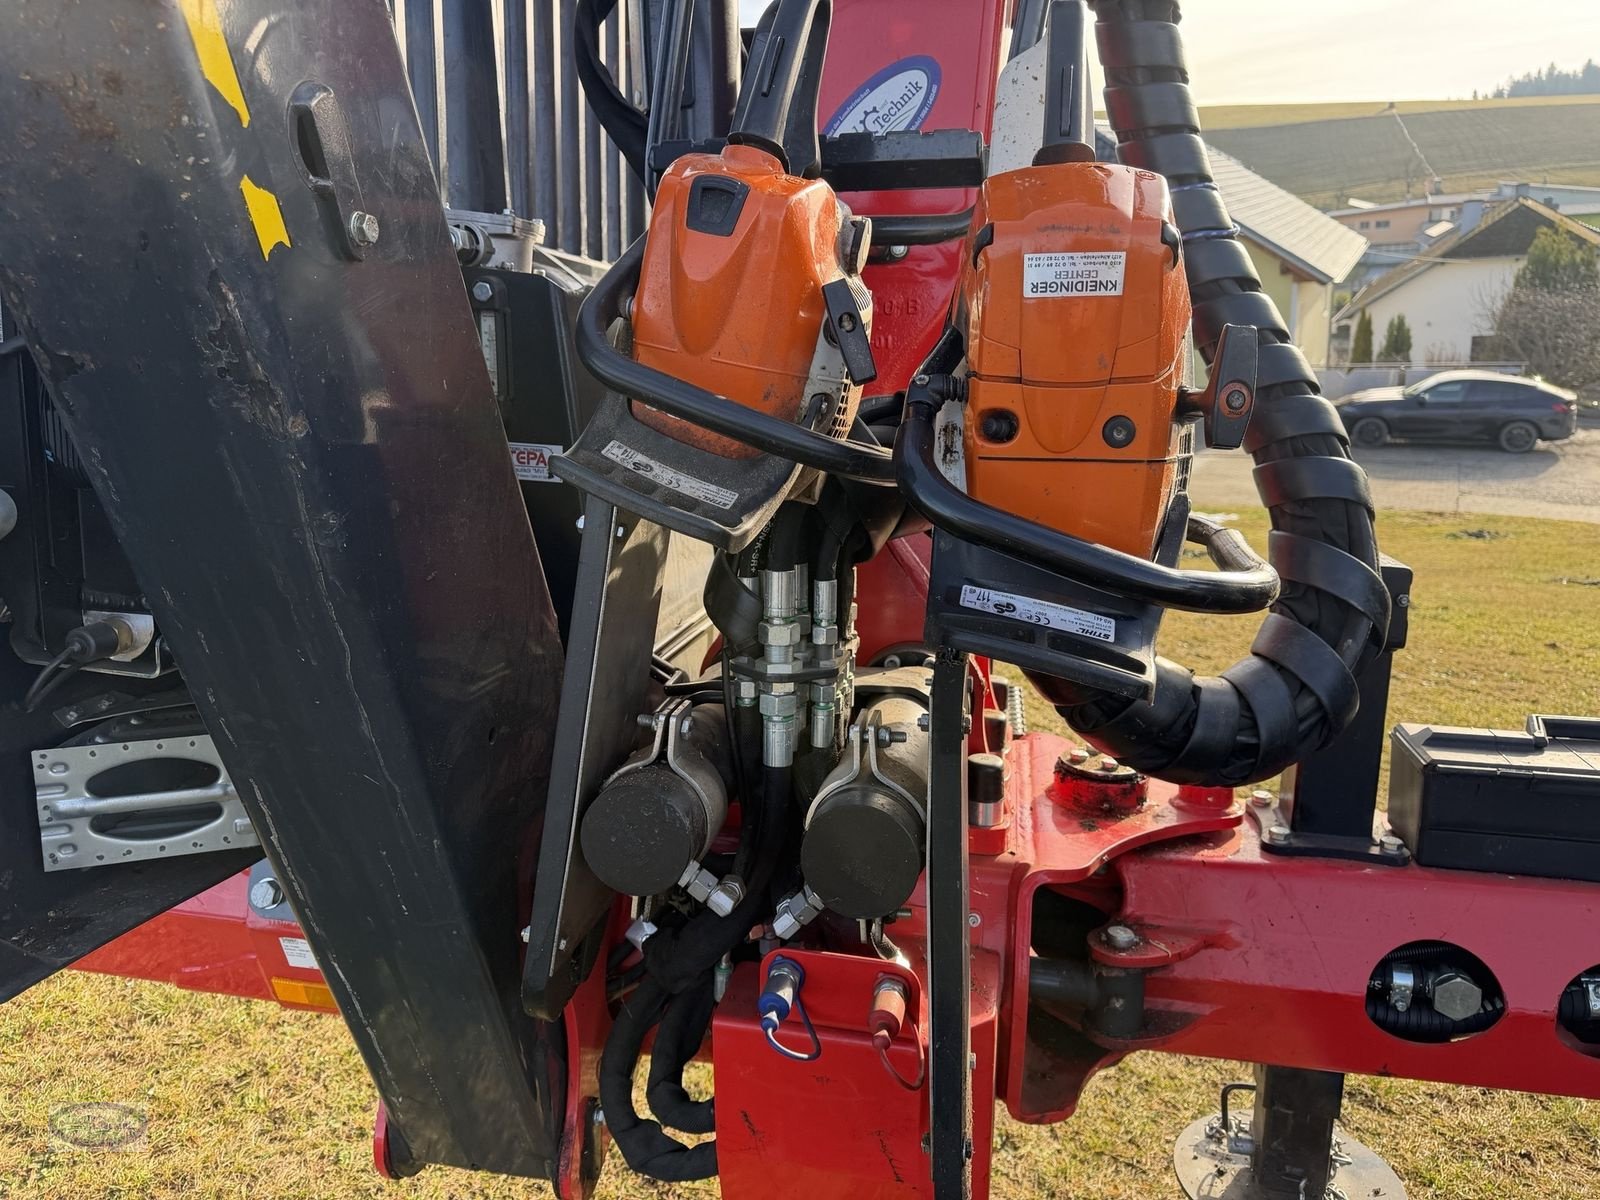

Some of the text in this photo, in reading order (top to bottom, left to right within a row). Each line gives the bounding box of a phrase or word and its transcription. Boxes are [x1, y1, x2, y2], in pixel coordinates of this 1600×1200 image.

[872, 81, 923, 129] Technik
[1054, 269, 1099, 280] CENTER
[1030, 279, 1118, 294] KNEIDINGER
[976, 591, 991, 602] 117
[1076, 627, 1112, 640] STIHL
